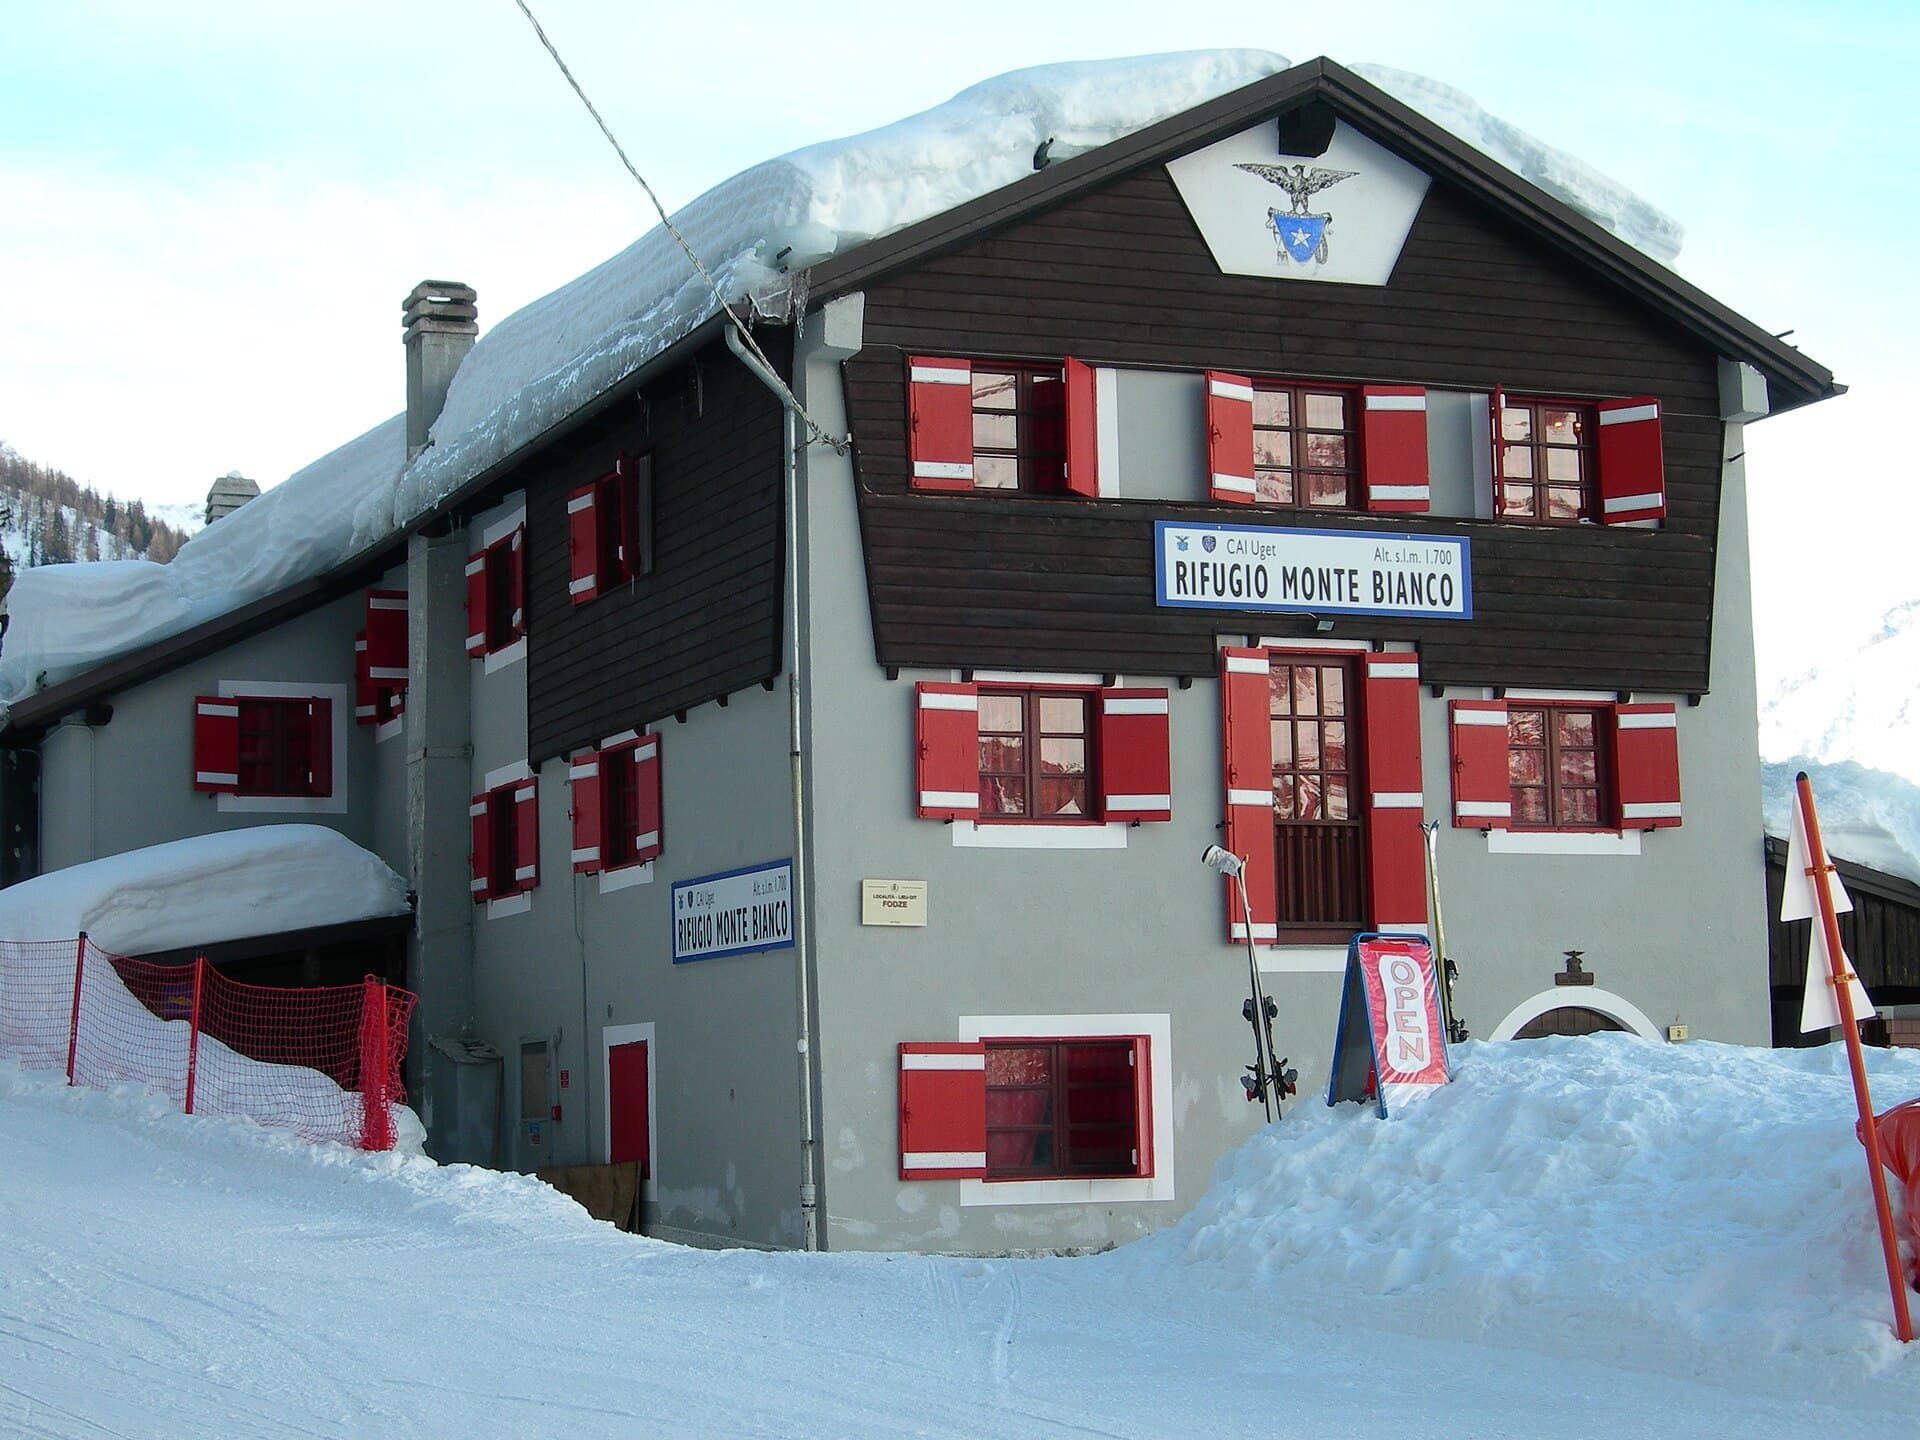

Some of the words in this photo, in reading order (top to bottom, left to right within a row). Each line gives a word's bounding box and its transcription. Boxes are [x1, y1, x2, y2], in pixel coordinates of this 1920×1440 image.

[1226, 537, 1248, 555] CAI
[1250, 540, 1277, 561] Uget
[1373, 546, 1393, 562] Alt.
[1394, 548, 1422, 565] s.l.m.
[1425, 549, 1452, 565] 1.700
[1175, 560, 1269, 598] RIFUGIO
[1281, 565, 1359, 603] MONTE
[1372, 569, 1453, 607] BIANCO
[678, 914, 712, 953] RIFUGIO
[716, 907, 748, 946] MONTE
[752, 900, 788, 941] BIANCO
[1390, 960, 1424, 1062] OPEN
